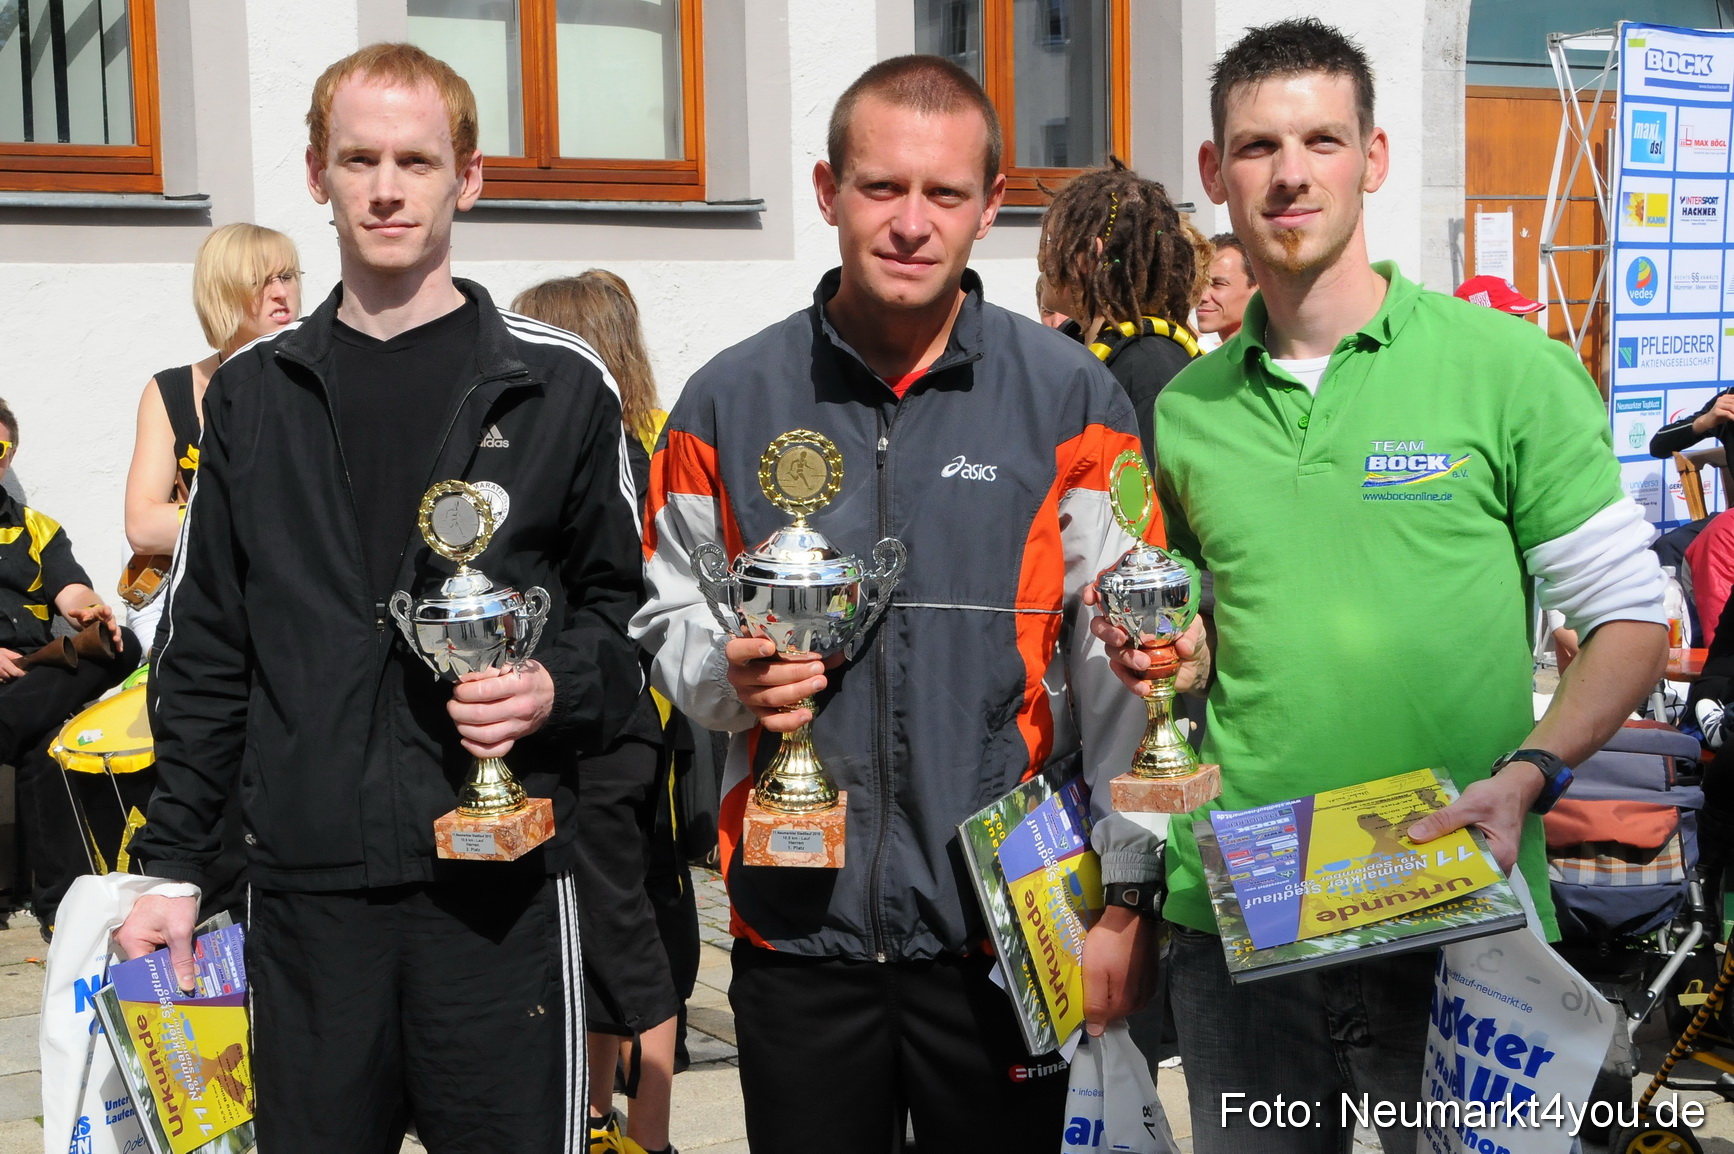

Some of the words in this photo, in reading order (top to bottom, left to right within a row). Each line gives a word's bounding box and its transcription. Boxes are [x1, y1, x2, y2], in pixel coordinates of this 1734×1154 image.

[1646, 48, 1714, 76] BOCK
[1633, 120, 1660, 140] maxi
[1649, 140, 1662, 155] dsl
[1693, 139, 1709, 147] MAX
[1710, 138, 1727, 147] BÖGL
[1685, 196, 1719, 205] INTERSPORT
[1646, 216, 1666, 225] KANN
[1682, 207, 1717, 216] HACKNER
[1629, 286, 1653, 299] vedes
[1641, 335, 1714, 355] PFLEIDERER
[1641, 357, 1714, 368] AKTIENGESELLSCHAFT
[1616, 401, 1642, 410] Neumarkter
[1642, 399, 1660, 409] Tagblatt
[477, 438, 509, 448] adidas
[1371, 440, 1425, 452] TEAM
[960, 462, 997, 482] asics
[1365, 454, 1451, 472] BOCK
[1629, 479, 1659, 489] universa
[1362, 491, 1453, 501] www.bockonline.de
[1026, 819, 1056, 882] Stadtlauf
[1319, 860, 1392, 882] September
[1320, 858, 1429, 889] Neumarkter
[1283, 878, 1316, 892] 2010
[1243, 883, 1322, 911] Stadtlauf
[1317, 877, 1474, 923] Urkunde
[1050, 881, 1085, 967] Neumarkter
[1023, 888, 1071, 1021] Urkunde
[144, 958, 170, 1020] Stadtlauf
[1447, 967, 1533, 1014] adtlauf-neumarkt.de
[162, 987, 175, 1014] 2010
[172, 1015, 195, 1075] September
[168, 1022, 198, 1101] Neumarkter
[136, 1013, 184, 1138] Urkunde
